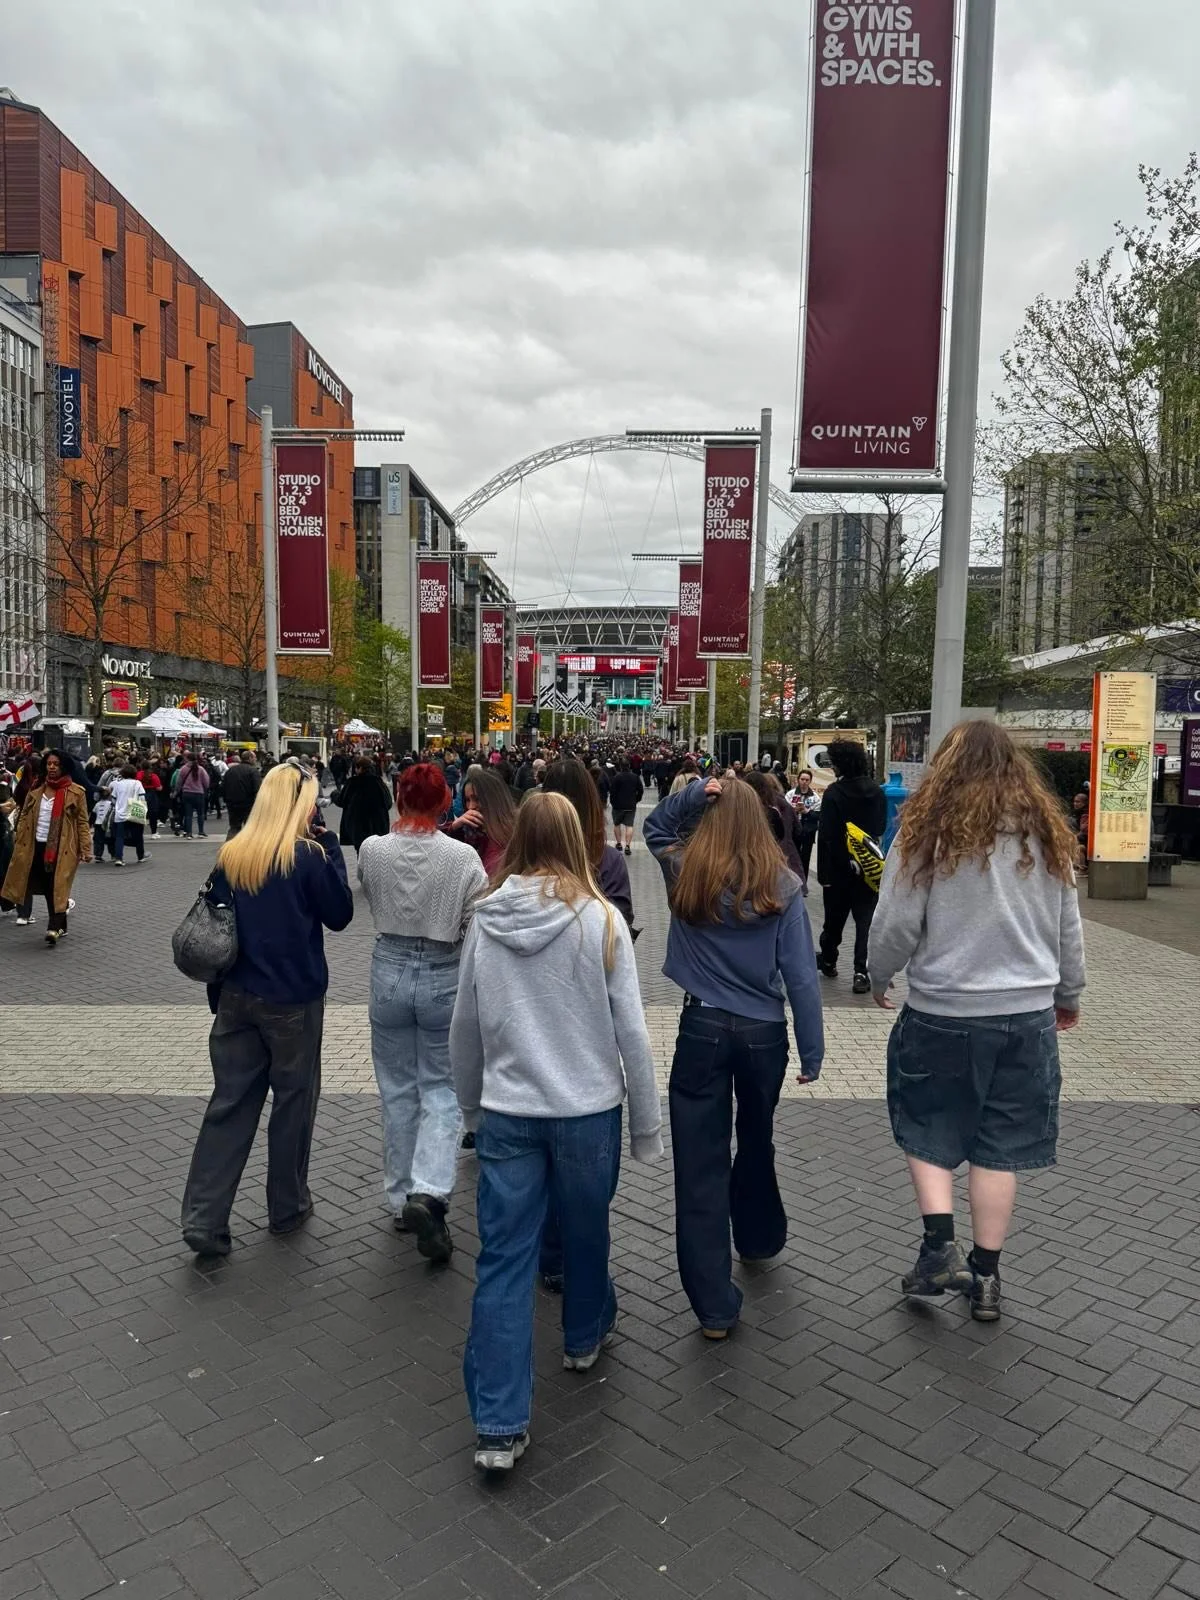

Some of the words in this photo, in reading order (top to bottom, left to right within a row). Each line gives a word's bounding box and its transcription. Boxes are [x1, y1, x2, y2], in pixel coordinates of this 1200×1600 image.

[823, 5, 913, 32] GYMS
[822, 33, 845, 59] &
[853, 32, 920, 57] WFH
[821, 59, 942, 87] SPACES.
[308, 349, 345, 407] NOVOTEL
[62, 373, 74, 446] NOVOTEL
[811, 425, 911, 440] QUINTAIN
[854, 440, 910, 454] LIVING
[278, 474, 321, 486] STUDIO
[707, 476, 750, 488] STUDIO
[279, 486, 289, 497] 1,
[291, 486, 302, 497] 2,
[304, 486, 312, 496] 3
[708, 488, 717, 499] 1,
[720, 488, 731, 500] 2,
[733, 488, 741, 498] 3
[279, 495, 296, 505] OR
[298, 495, 307, 506] 4
[706, 498, 724, 508] OR
[727, 498, 735, 508] 4
[279, 506, 301, 516] BED
[706, 508, 728, 518] BED
[279, 516, 323, 527] STYLISH
[705, 519, 750, 529] STYLISH
[280, 526, 325, 537] HOMES.
[706, 529, 750, 540] HOMES.
[102, 653, 154, 679] NOVOTEL
